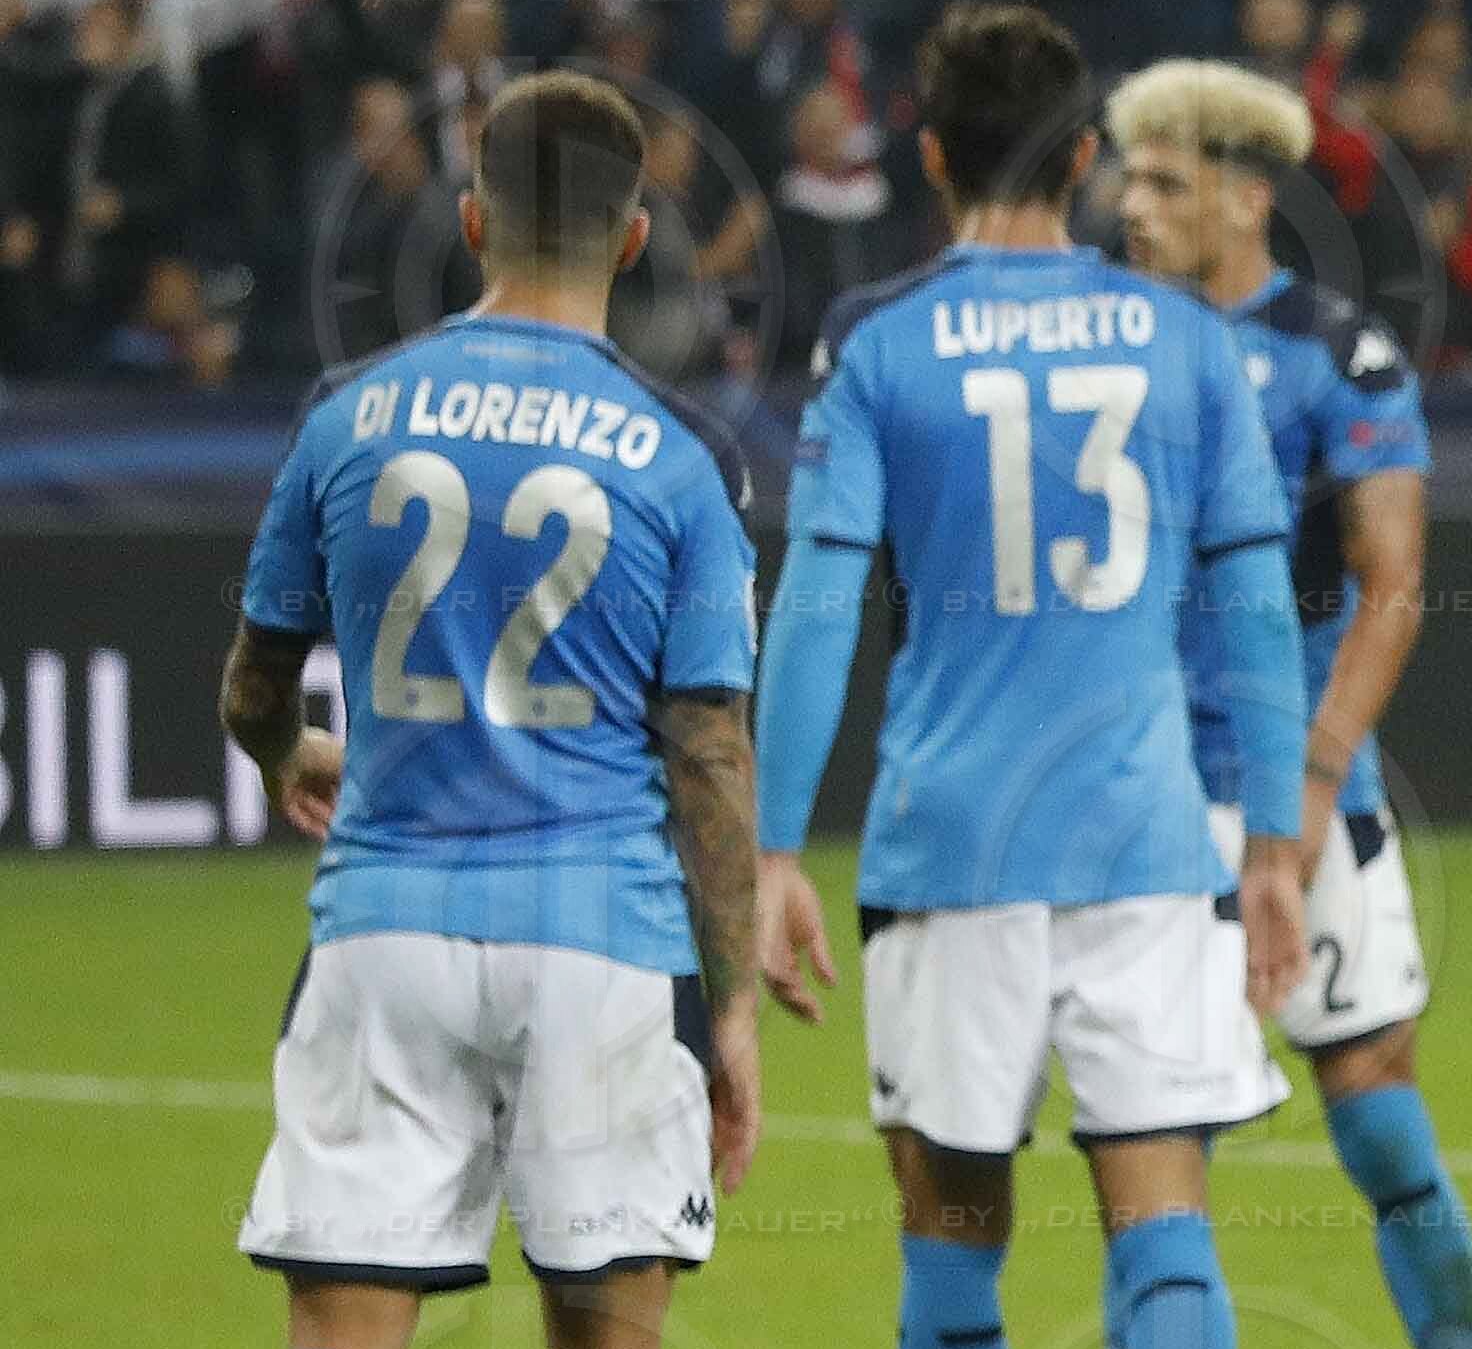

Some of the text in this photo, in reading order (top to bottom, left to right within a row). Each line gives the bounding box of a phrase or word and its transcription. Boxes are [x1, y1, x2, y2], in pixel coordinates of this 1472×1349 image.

[933, 293, 1155, 360] LUPERTO
[353, 377, 662, 470] DI LORENZO
[961, 364, 1150, 616] 13
[368, 450, 613, 729] 22
